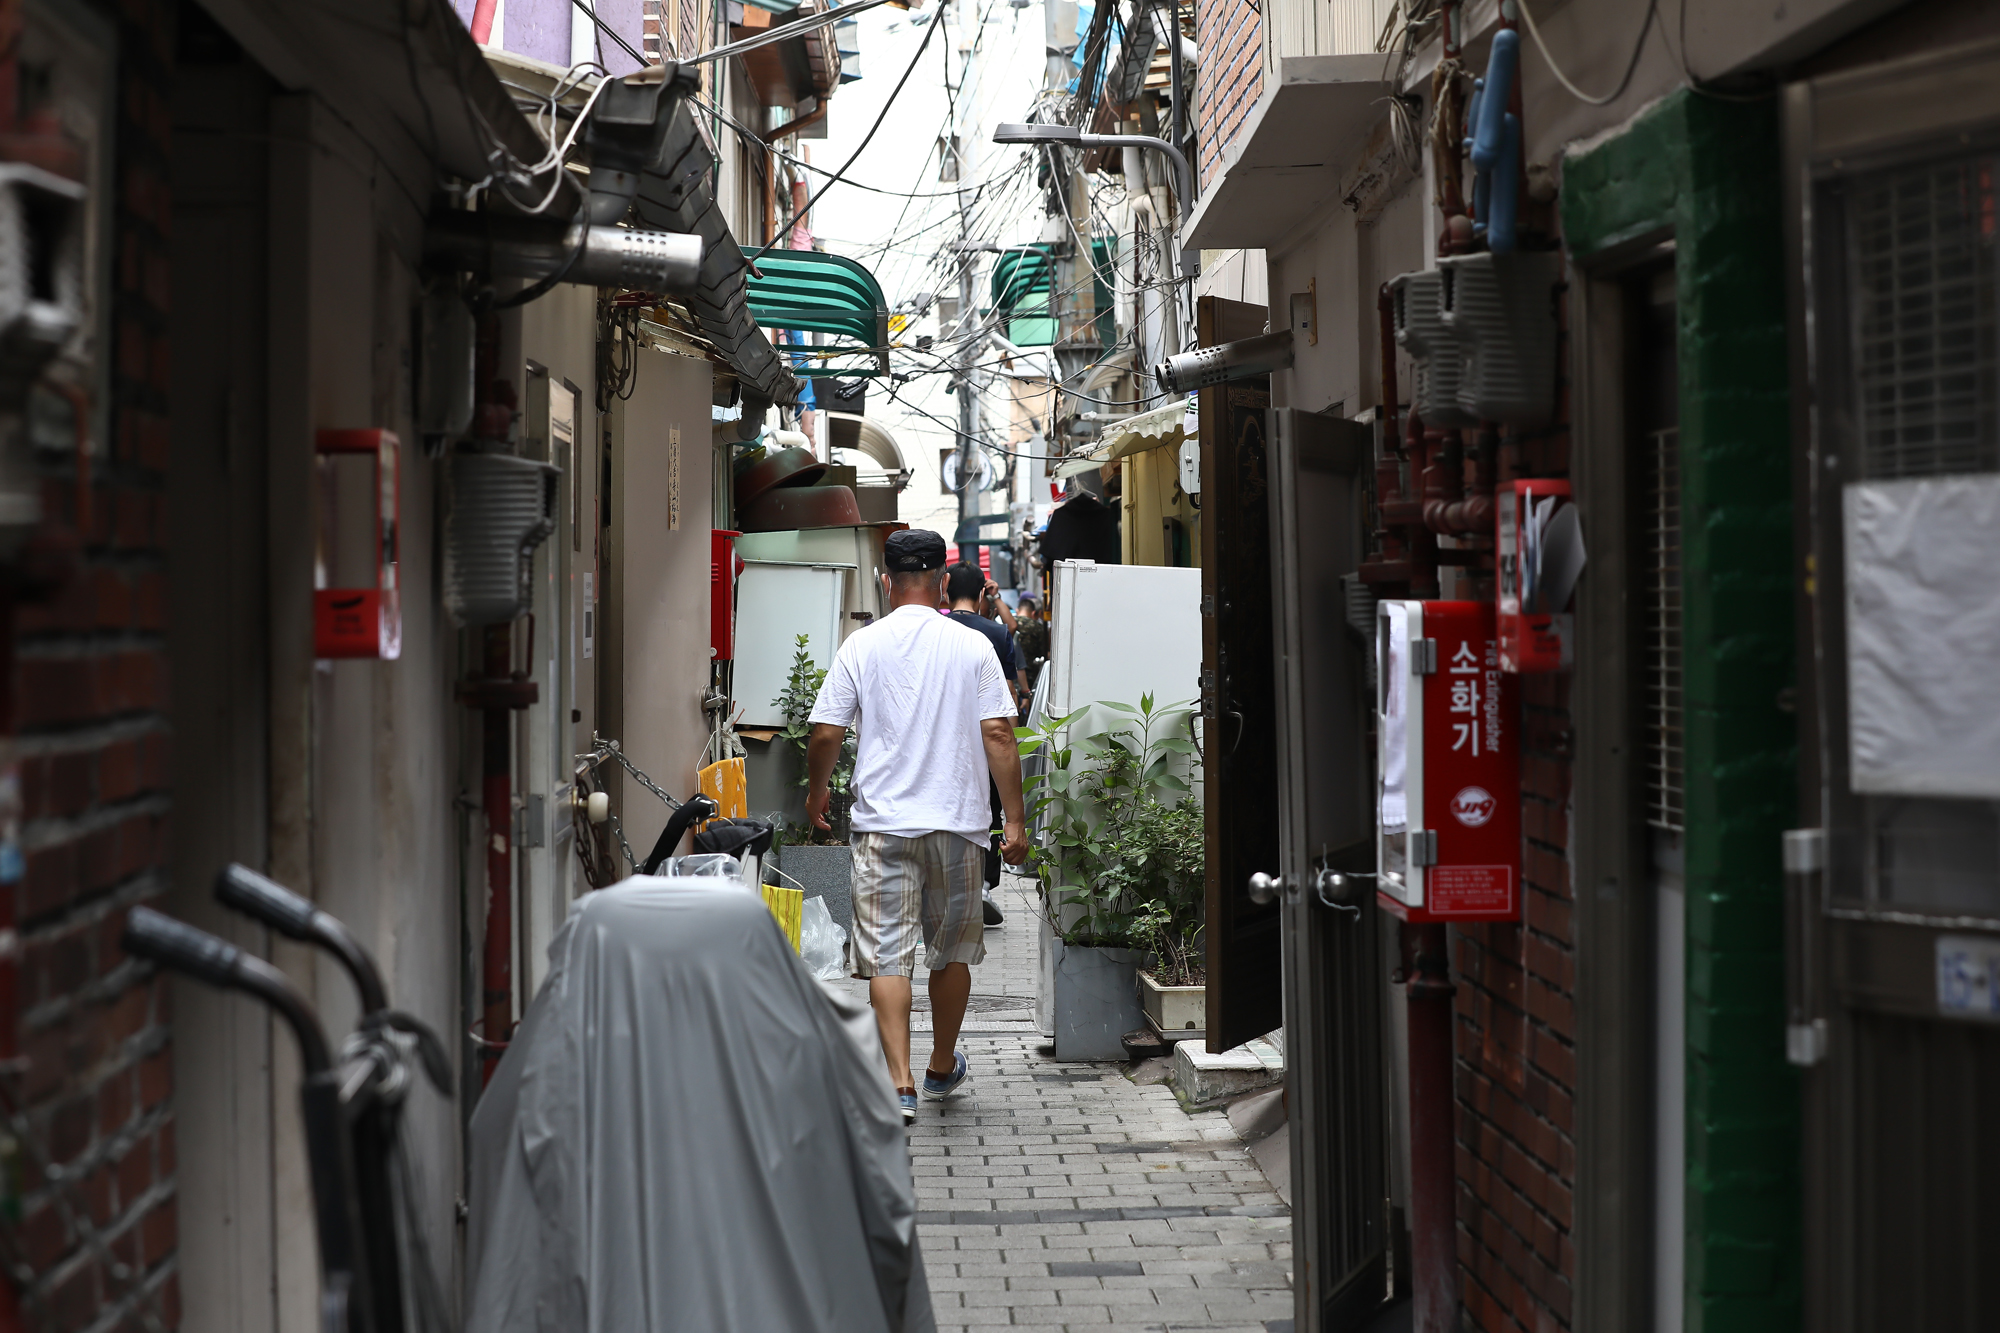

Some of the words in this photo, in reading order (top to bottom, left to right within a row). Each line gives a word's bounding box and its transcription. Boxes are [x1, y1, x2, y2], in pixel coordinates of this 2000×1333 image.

[1485, 640, 1499, 666] Fire
[1449, 640, 1481, 757] 소화기
[1483, 669, 1502, 753] Extinguisher
